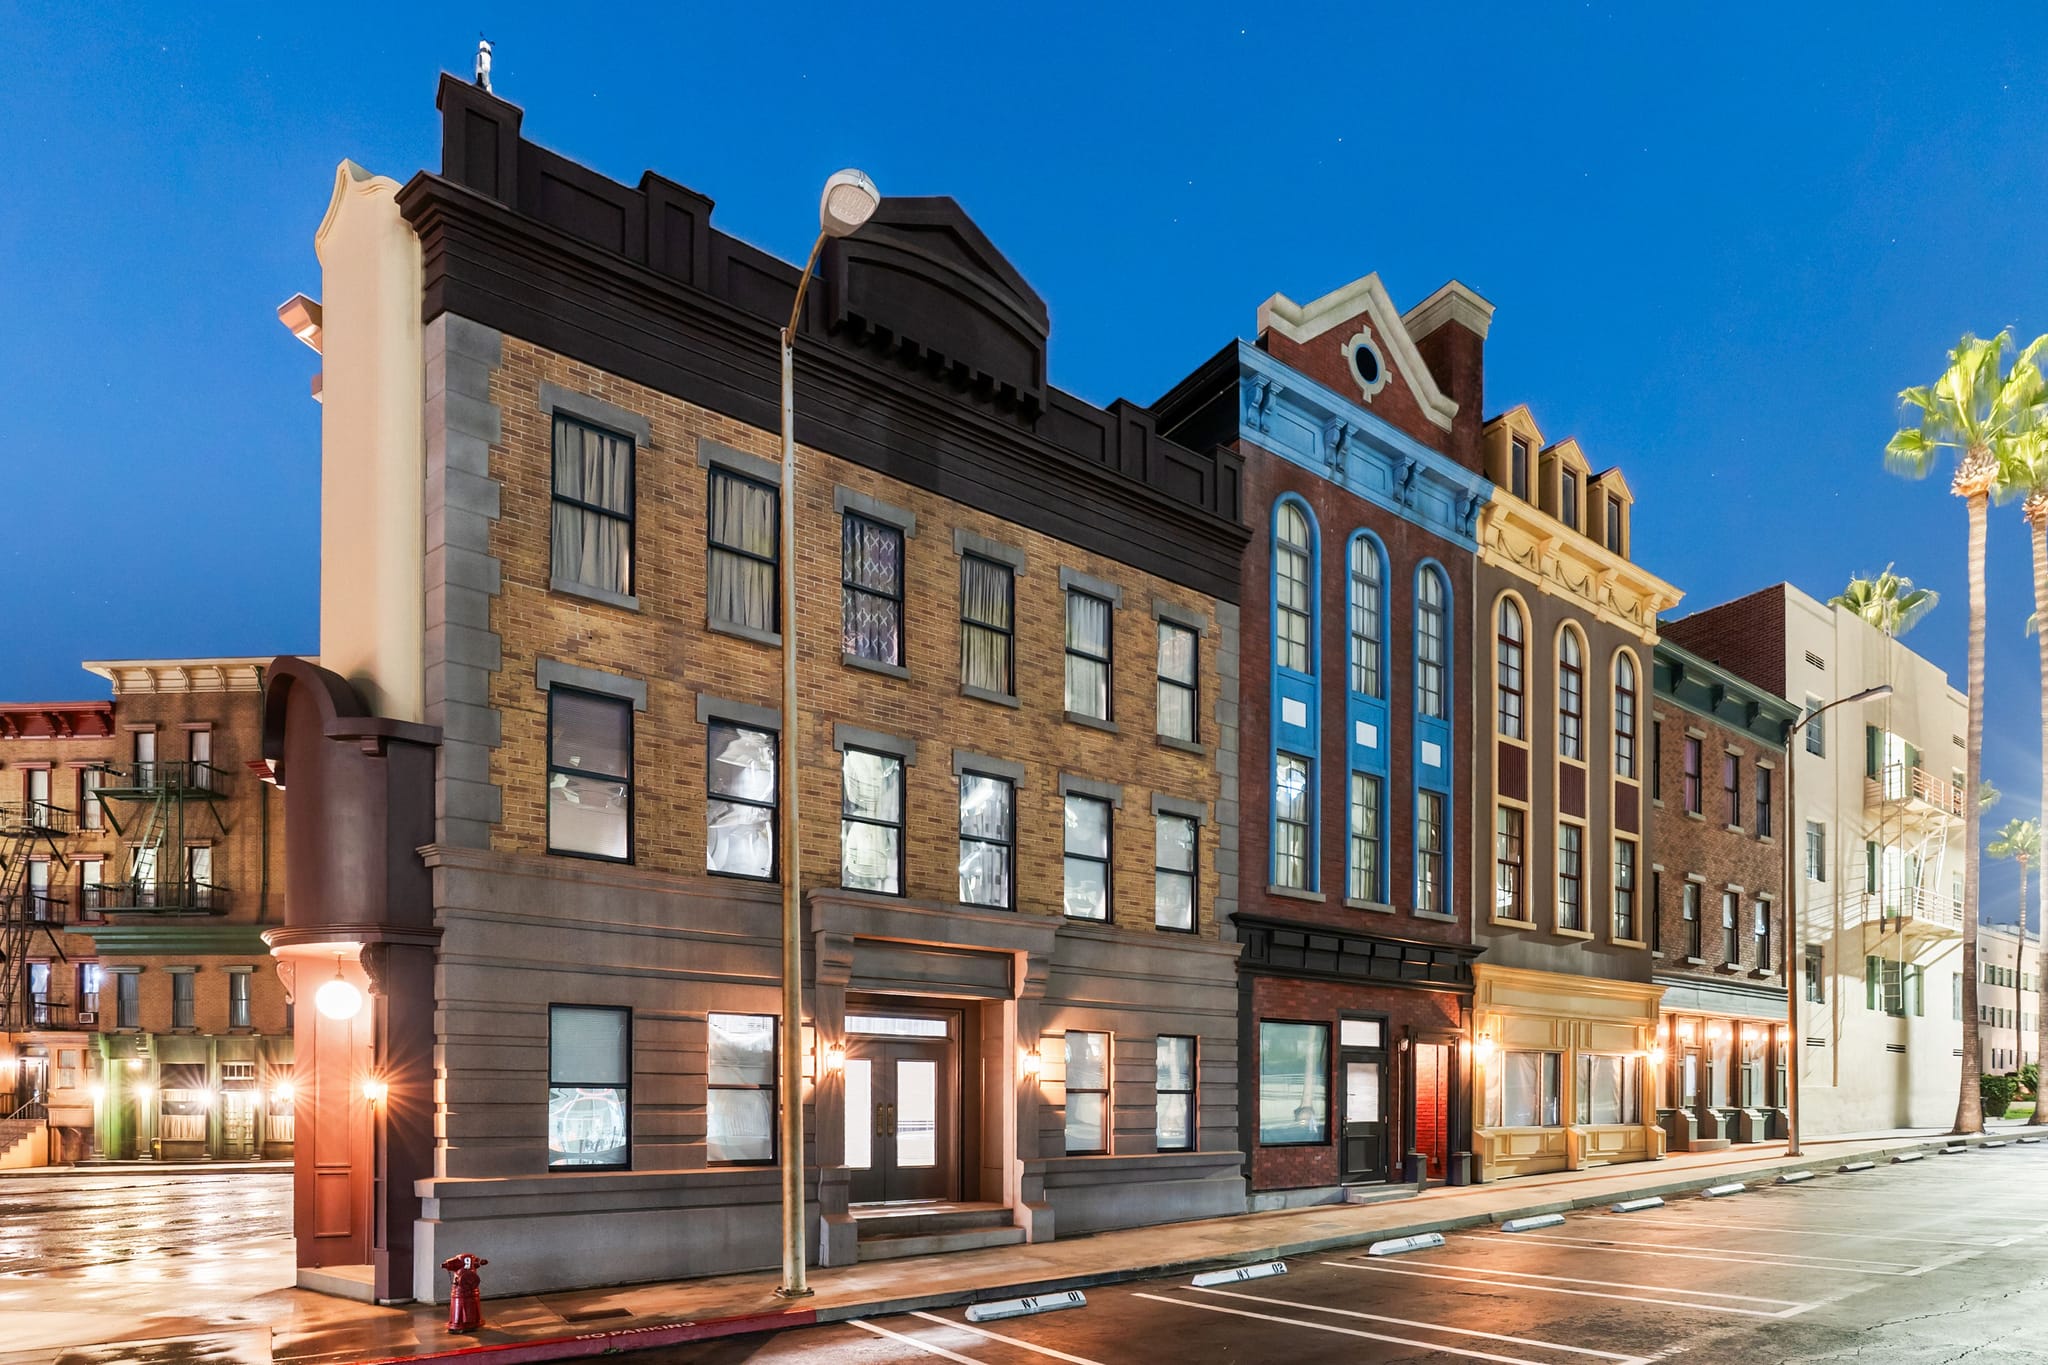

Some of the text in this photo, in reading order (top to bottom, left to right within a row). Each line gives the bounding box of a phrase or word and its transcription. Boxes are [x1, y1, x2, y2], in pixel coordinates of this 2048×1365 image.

[464, 1257, 471, 1270] 9
[1236, 1263, 1286, 1281] NY 02
[1021, 1291, 1081, 1309] NY 01
[575, 1322, 697, 1340] NO PARKING
